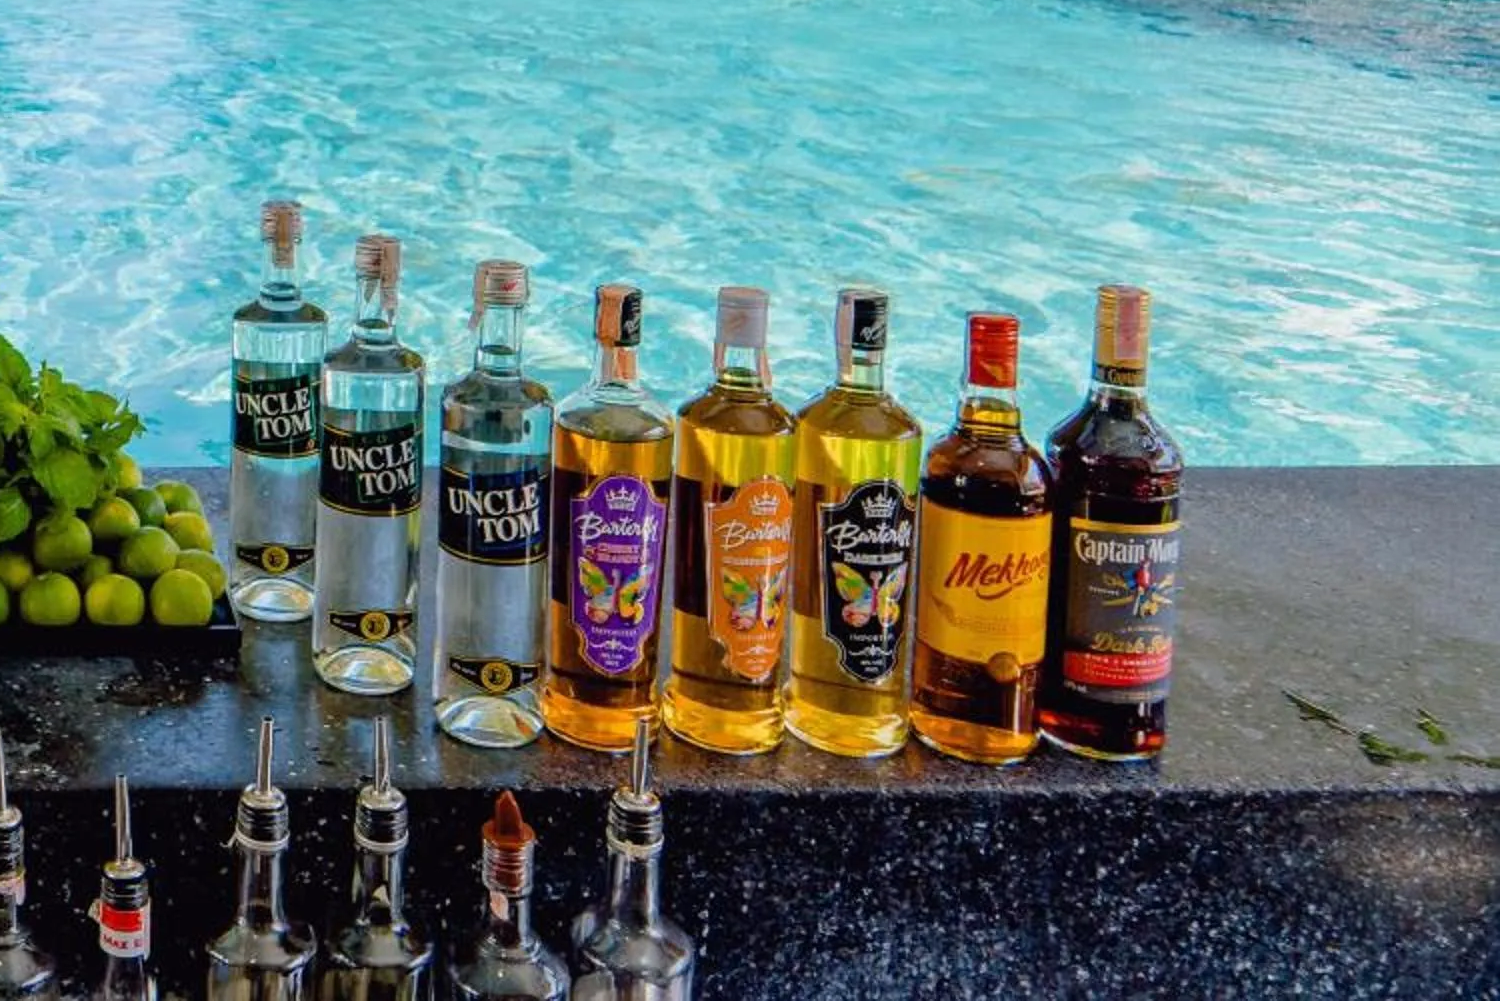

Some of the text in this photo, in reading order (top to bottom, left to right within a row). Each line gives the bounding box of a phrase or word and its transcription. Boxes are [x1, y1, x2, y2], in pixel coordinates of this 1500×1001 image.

[235, 387, 311, 416] UNCLE
[257, 410, 313, 439] TOM
[330, 438, 415, 471] UNCLE
[359, 462, 416, 495] TOM
[448, 482, 540, 516] UNCLE
[477, 507, 540, 543] TOM
[1074, 532, 1146, 566] Captain
